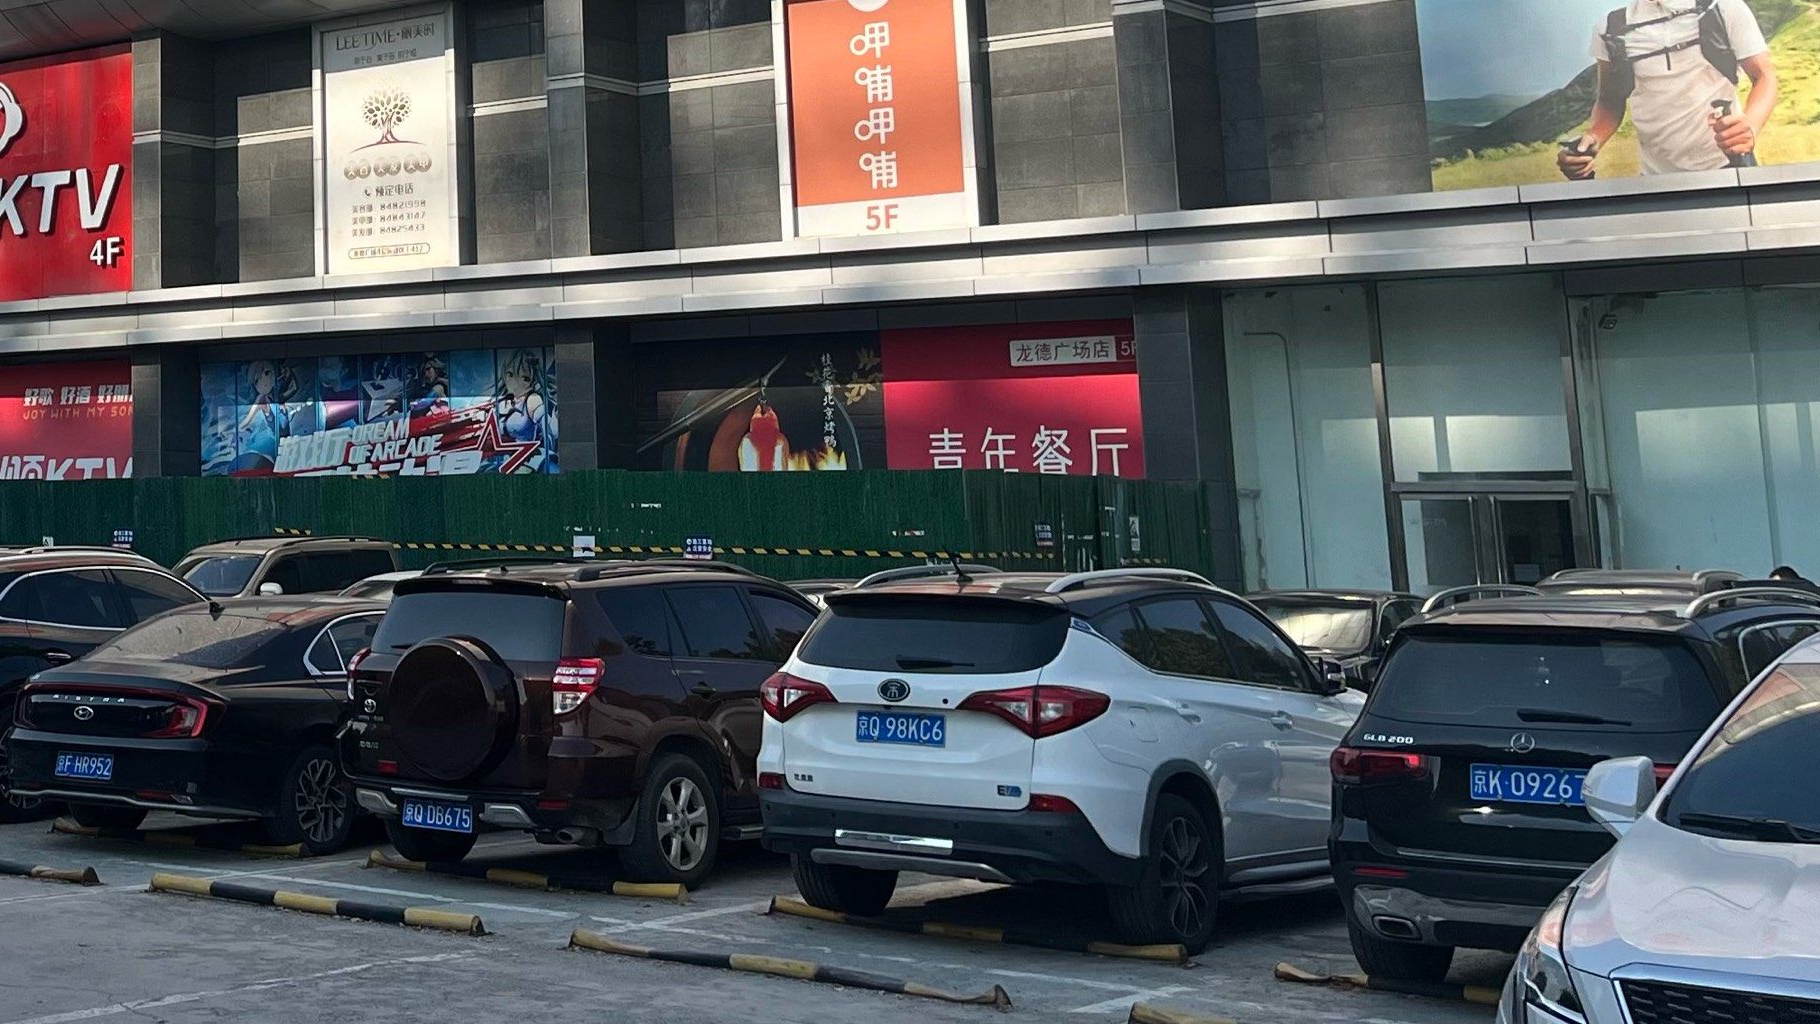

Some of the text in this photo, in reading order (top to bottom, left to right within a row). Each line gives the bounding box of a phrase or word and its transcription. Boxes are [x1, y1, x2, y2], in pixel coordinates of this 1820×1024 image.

[850, 22, 898, 189] 呷哺呷哺
[865, 204, 900, 231] 5F
[89, 237, 123, 266] 4F
[1016, 341, 1110, 363] 龙德广场店
[50, 408, 79, 419] WITH
[87, 407, 104, 418] MY
[351, 416, 411, 445] DREAM
[371, 433, 442, 461] ARCADE
[1388, 735, 1414, 745] 200
